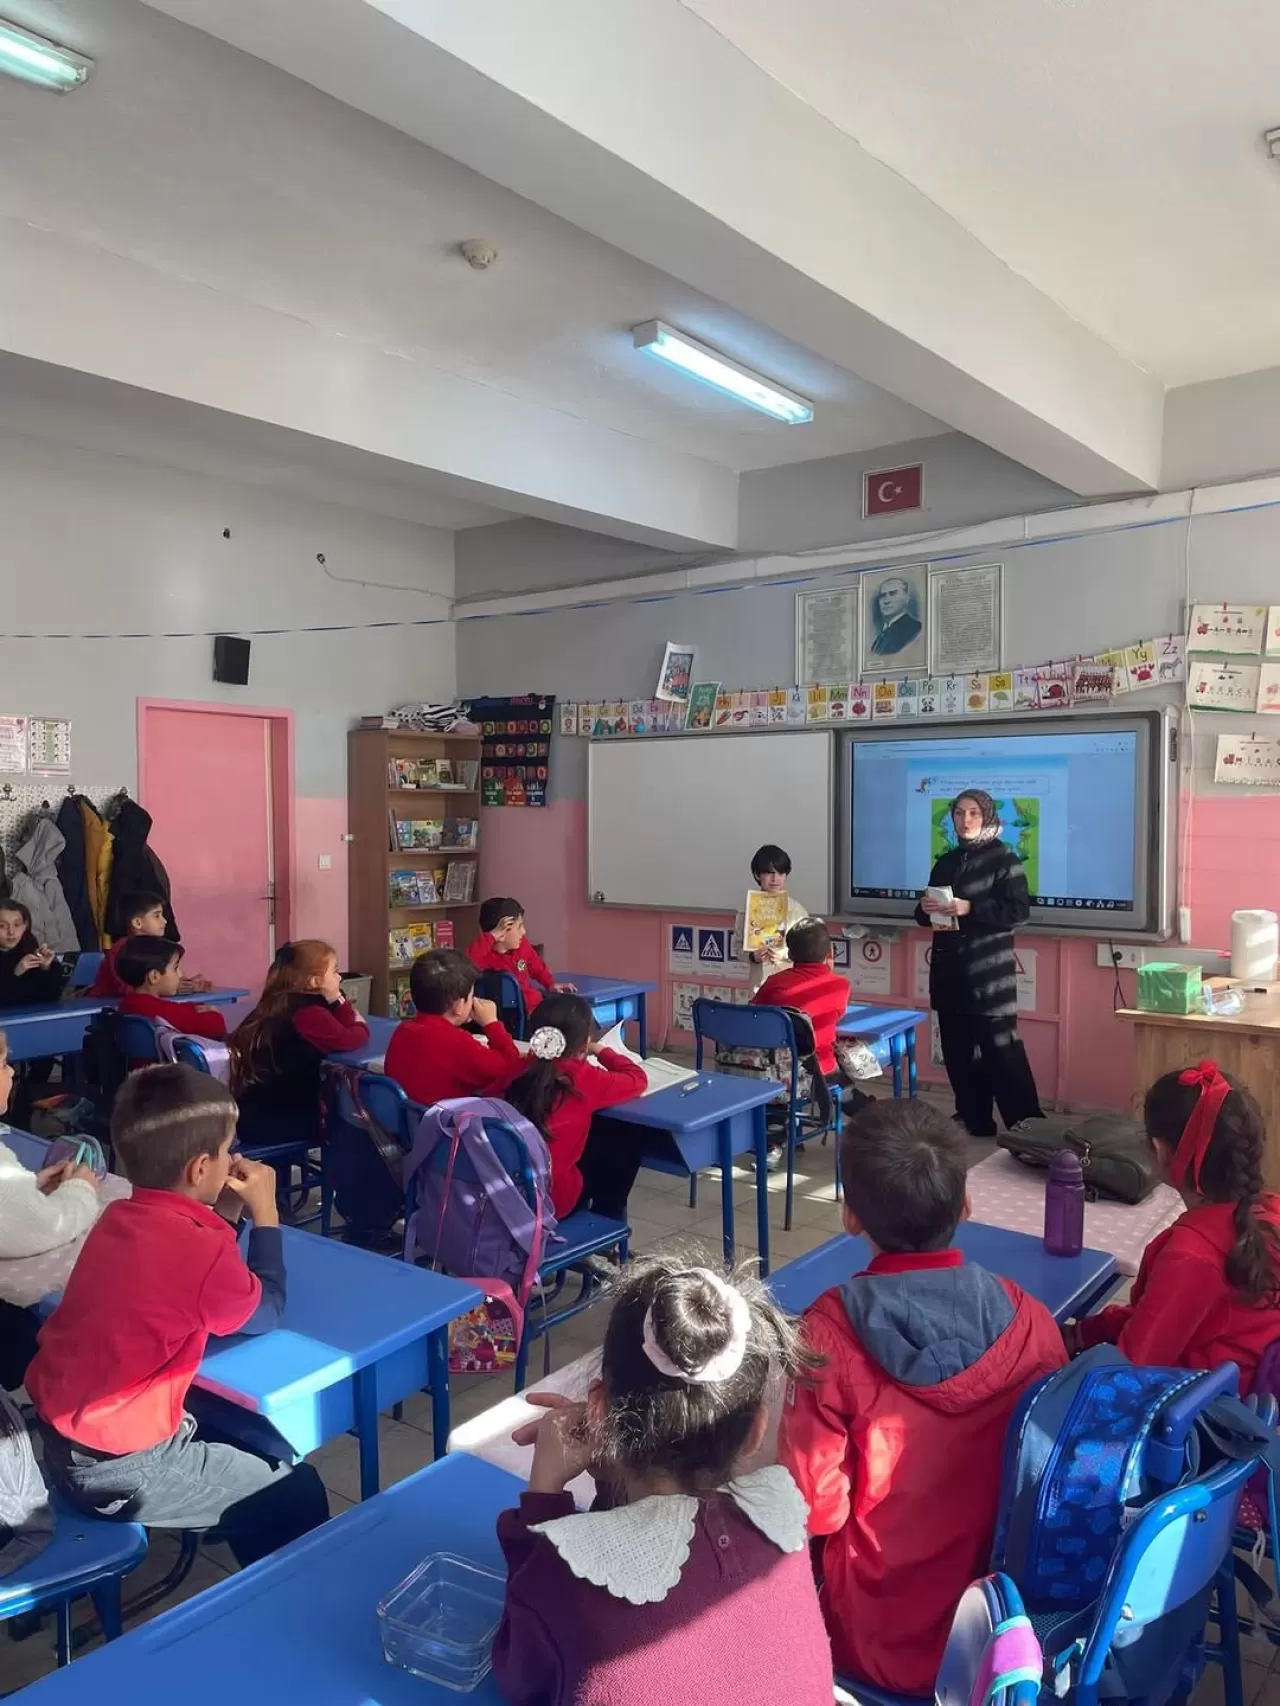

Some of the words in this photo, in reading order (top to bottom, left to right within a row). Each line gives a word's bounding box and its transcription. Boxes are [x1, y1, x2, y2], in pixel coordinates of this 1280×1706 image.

[1162, 642, 1178, 655] Zz
[947, 680, 957, 692] Rr
[1018, 674, 1028, 686] Tt
[853, 687, 867, 698] Nn
[922, 680, 934, 694] Pp
